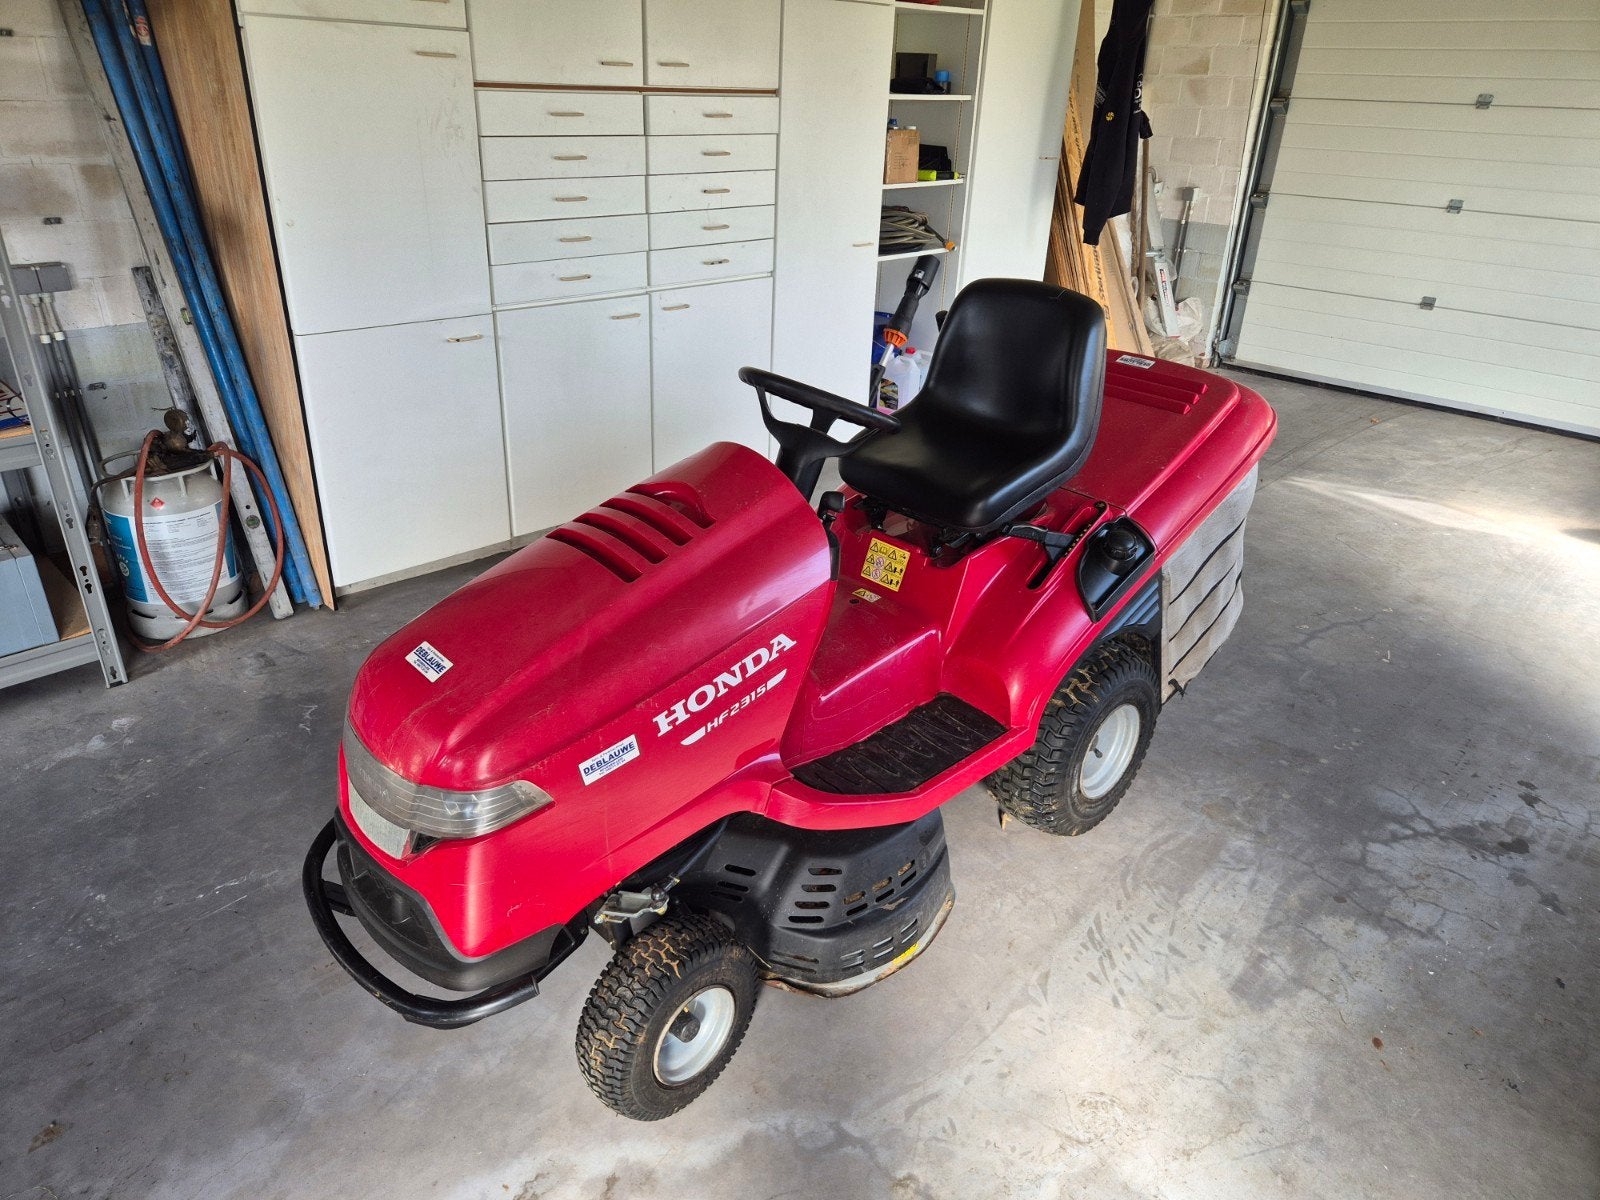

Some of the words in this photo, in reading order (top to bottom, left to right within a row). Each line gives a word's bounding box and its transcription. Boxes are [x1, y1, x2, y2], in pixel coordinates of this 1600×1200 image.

[415, 646, 447, 673] DEBLAUWE
[652, 633, 798, 737] HONDA
[707, 684, 767, 733] HF2315
[583, 741, 635, 775] DEBLAUWE
